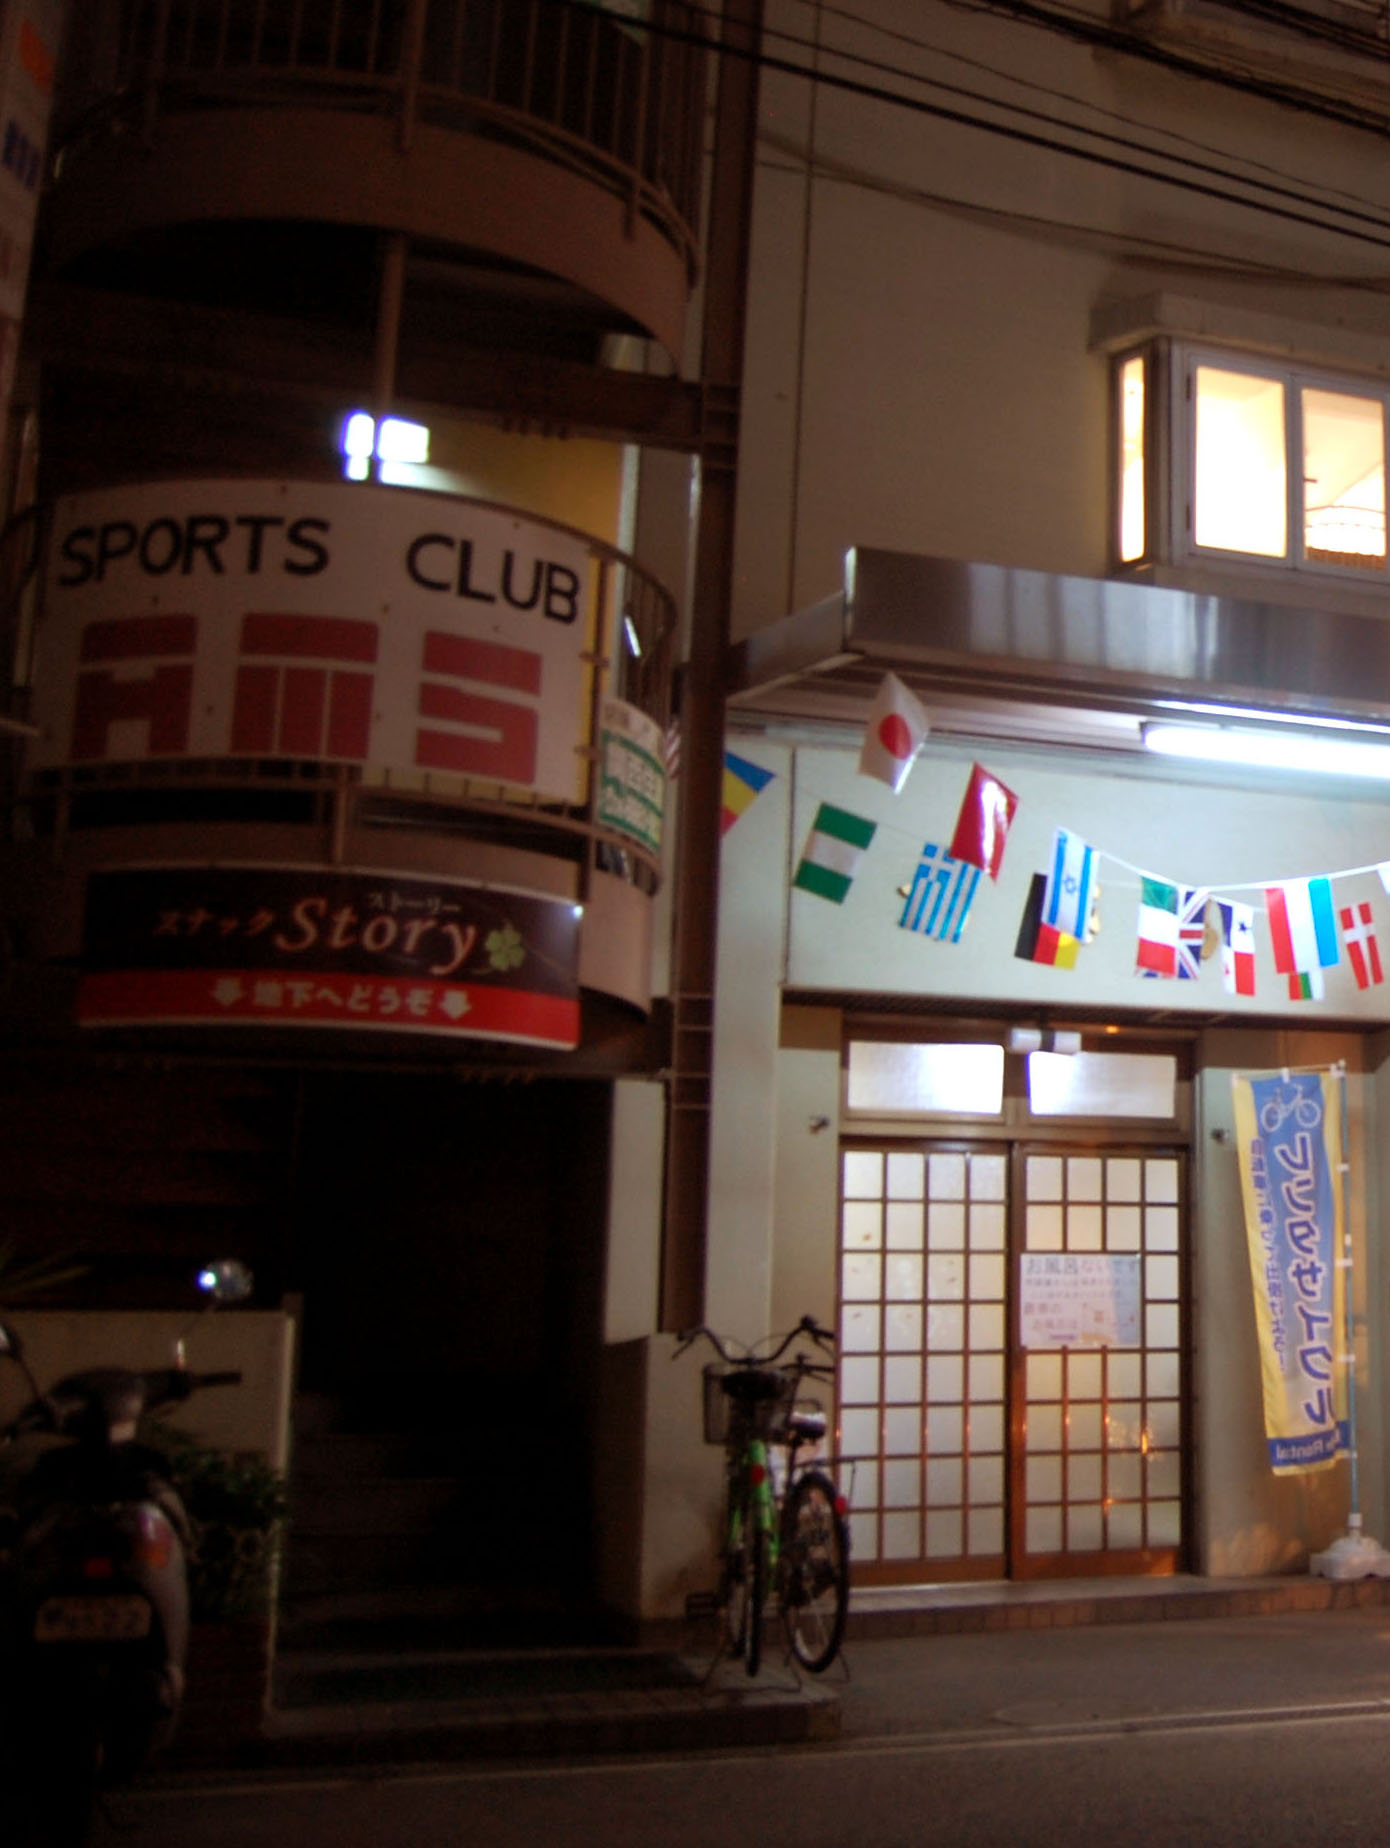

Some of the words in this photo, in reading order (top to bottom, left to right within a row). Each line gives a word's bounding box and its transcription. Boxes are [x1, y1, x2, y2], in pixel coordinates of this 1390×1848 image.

[59, 515, 331, 588] SPORTS
[406, 533, 580, 625] CLUB
[368, 890, 461, 914] ストーリー
[152, 907, 274, 939] スナック
[274, 897, 480, 975] Story
[253, 979, 434, 1016] 地下へどうぞ
